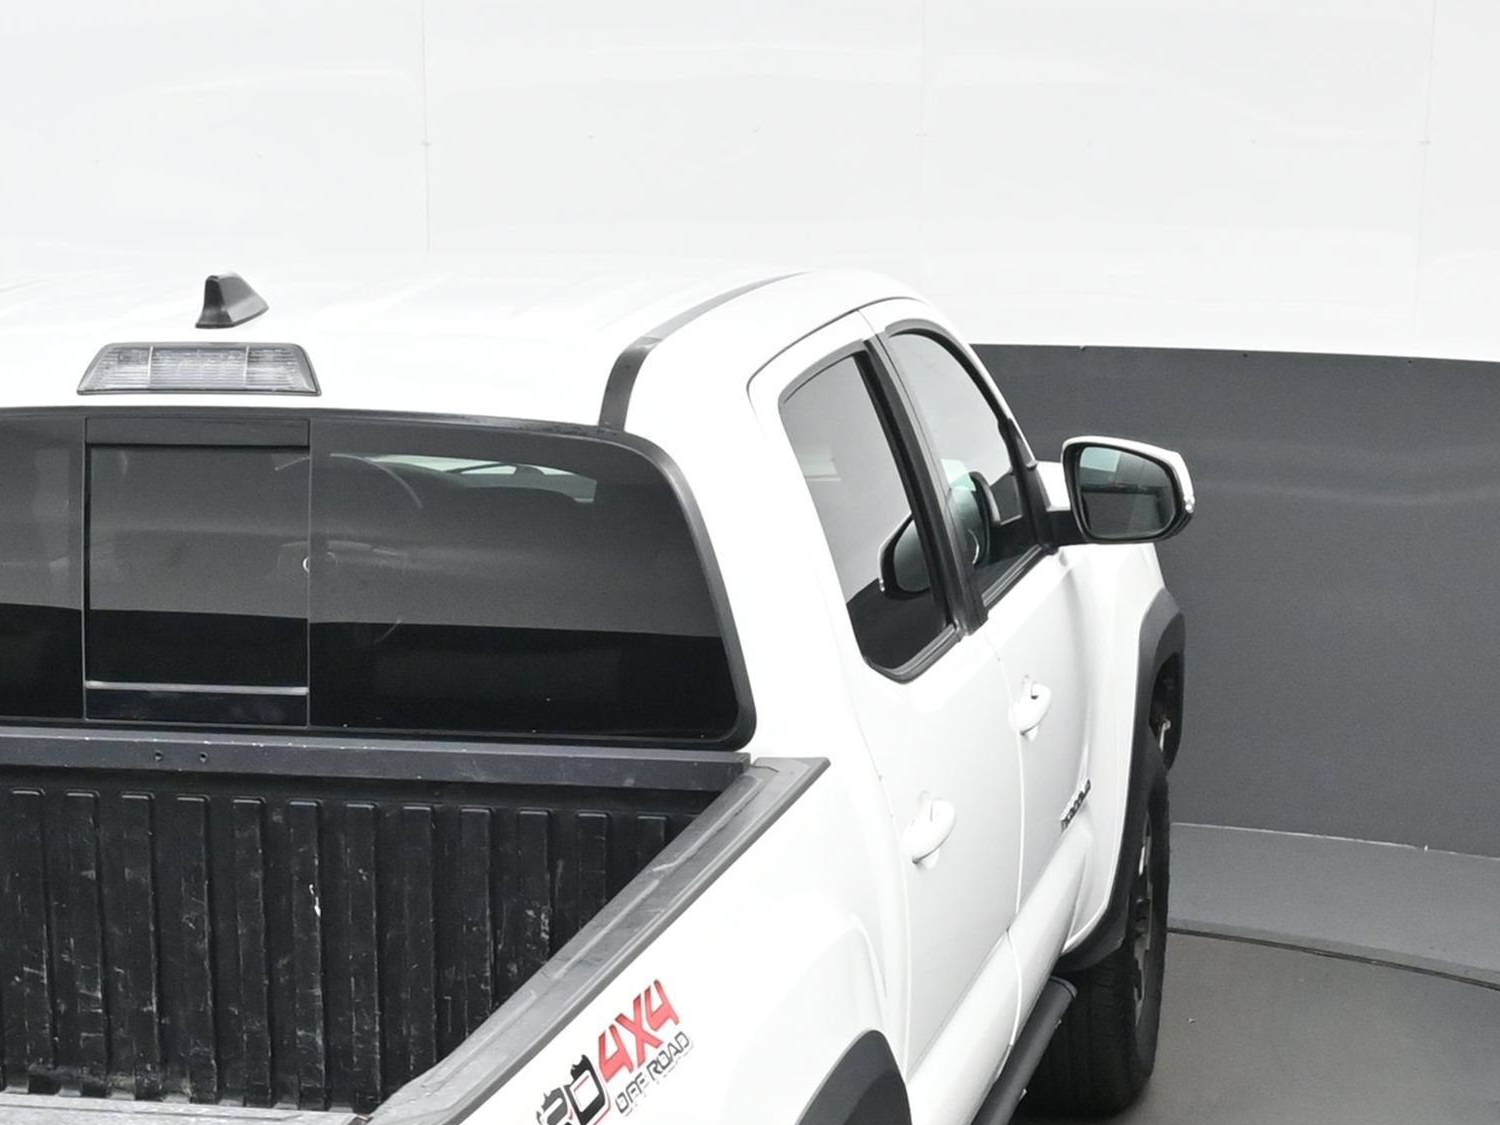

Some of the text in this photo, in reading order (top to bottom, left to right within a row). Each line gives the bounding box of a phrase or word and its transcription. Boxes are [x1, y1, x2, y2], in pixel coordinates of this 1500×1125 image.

[598, 979, 680, 1083] 4X4
[614, 1031, 690, 1114] OFF ROAD
